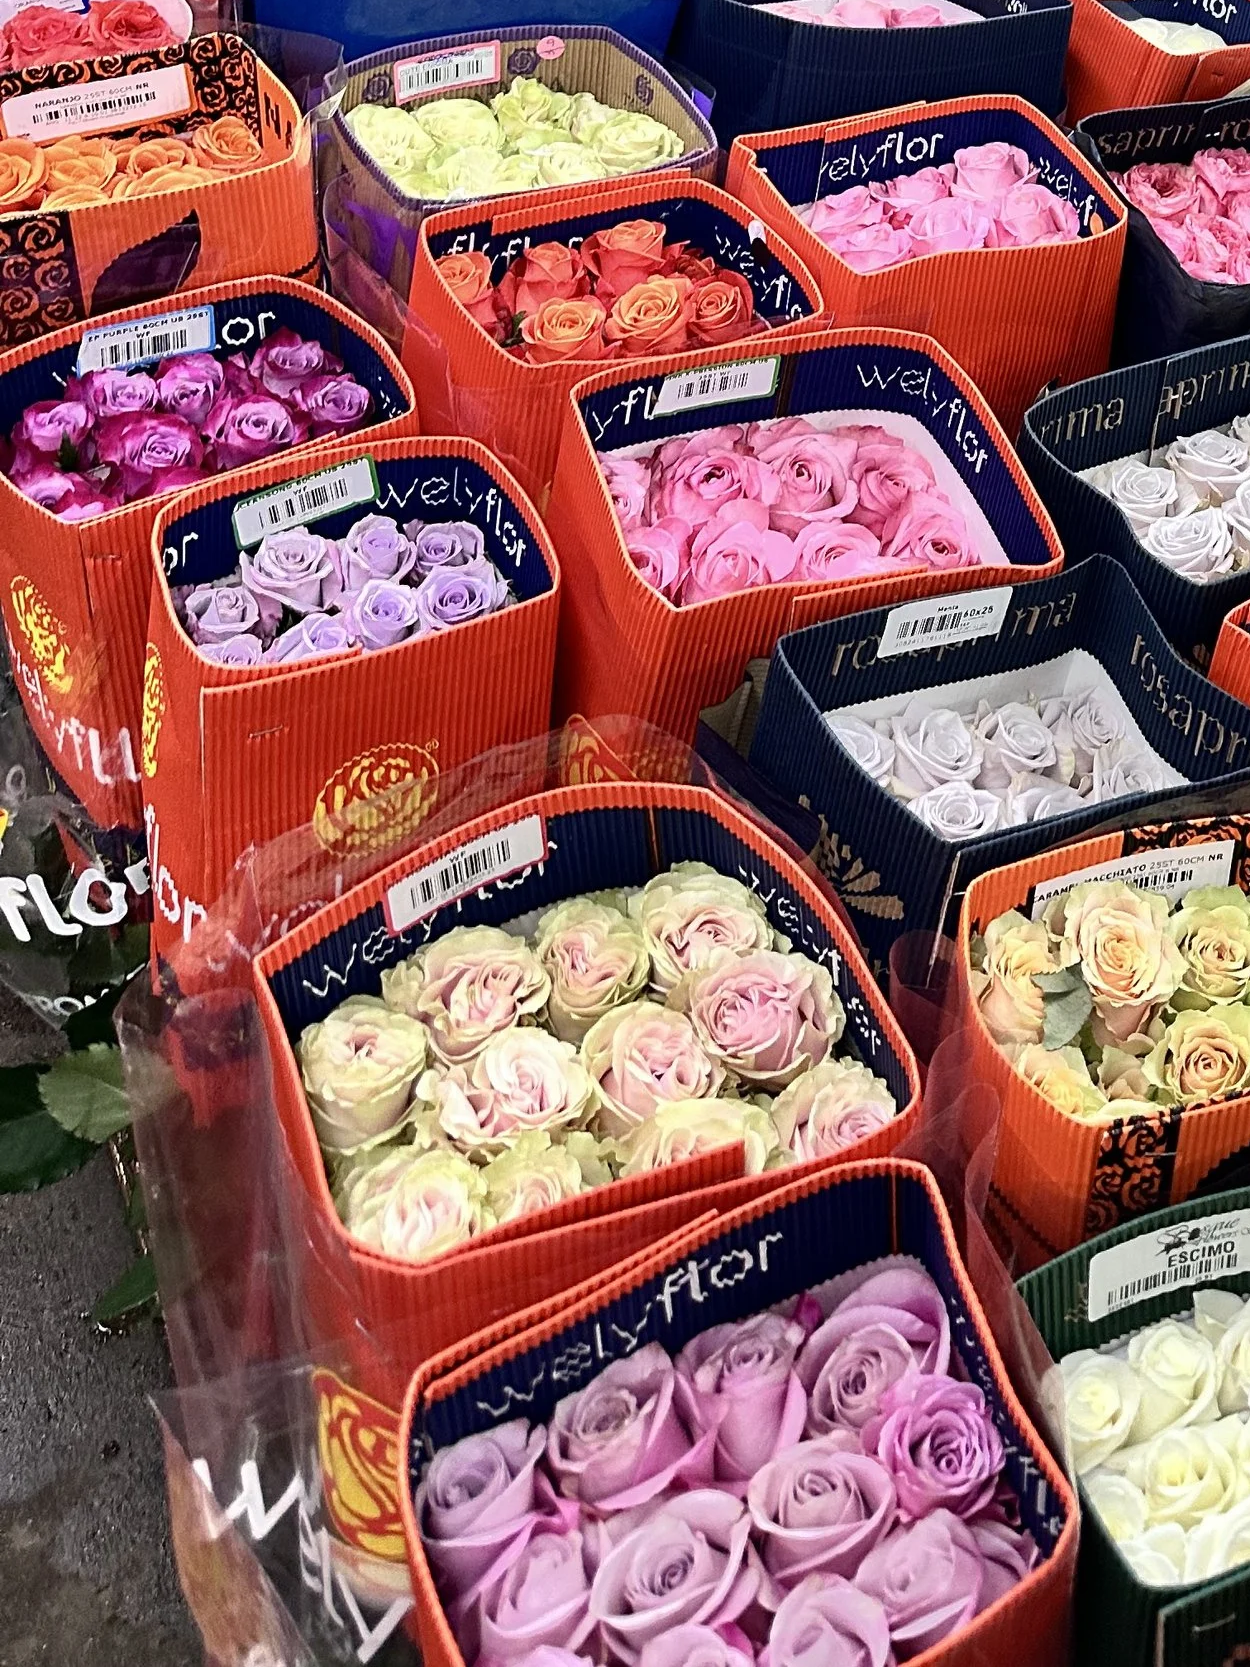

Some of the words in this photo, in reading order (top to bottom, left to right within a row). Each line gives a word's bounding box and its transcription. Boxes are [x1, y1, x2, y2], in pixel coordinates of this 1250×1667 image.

[34, 95, 82, 110] NARANJO
[135, 82, 149, 91] NR
[103, 325, 139, 340] PURPLE
[856, 362, 989, 474] welyflor
[375, 466, 529, 568] welyflor
[962, 603, 995, 619] 60x25
[1177, 854, 1205, 866] 60CM
[1207, 852, 1224, 863] NR
[1167, 1240, 1236, 1269] ESCIMO
[477, 1231, 784, 1420] welyflor
